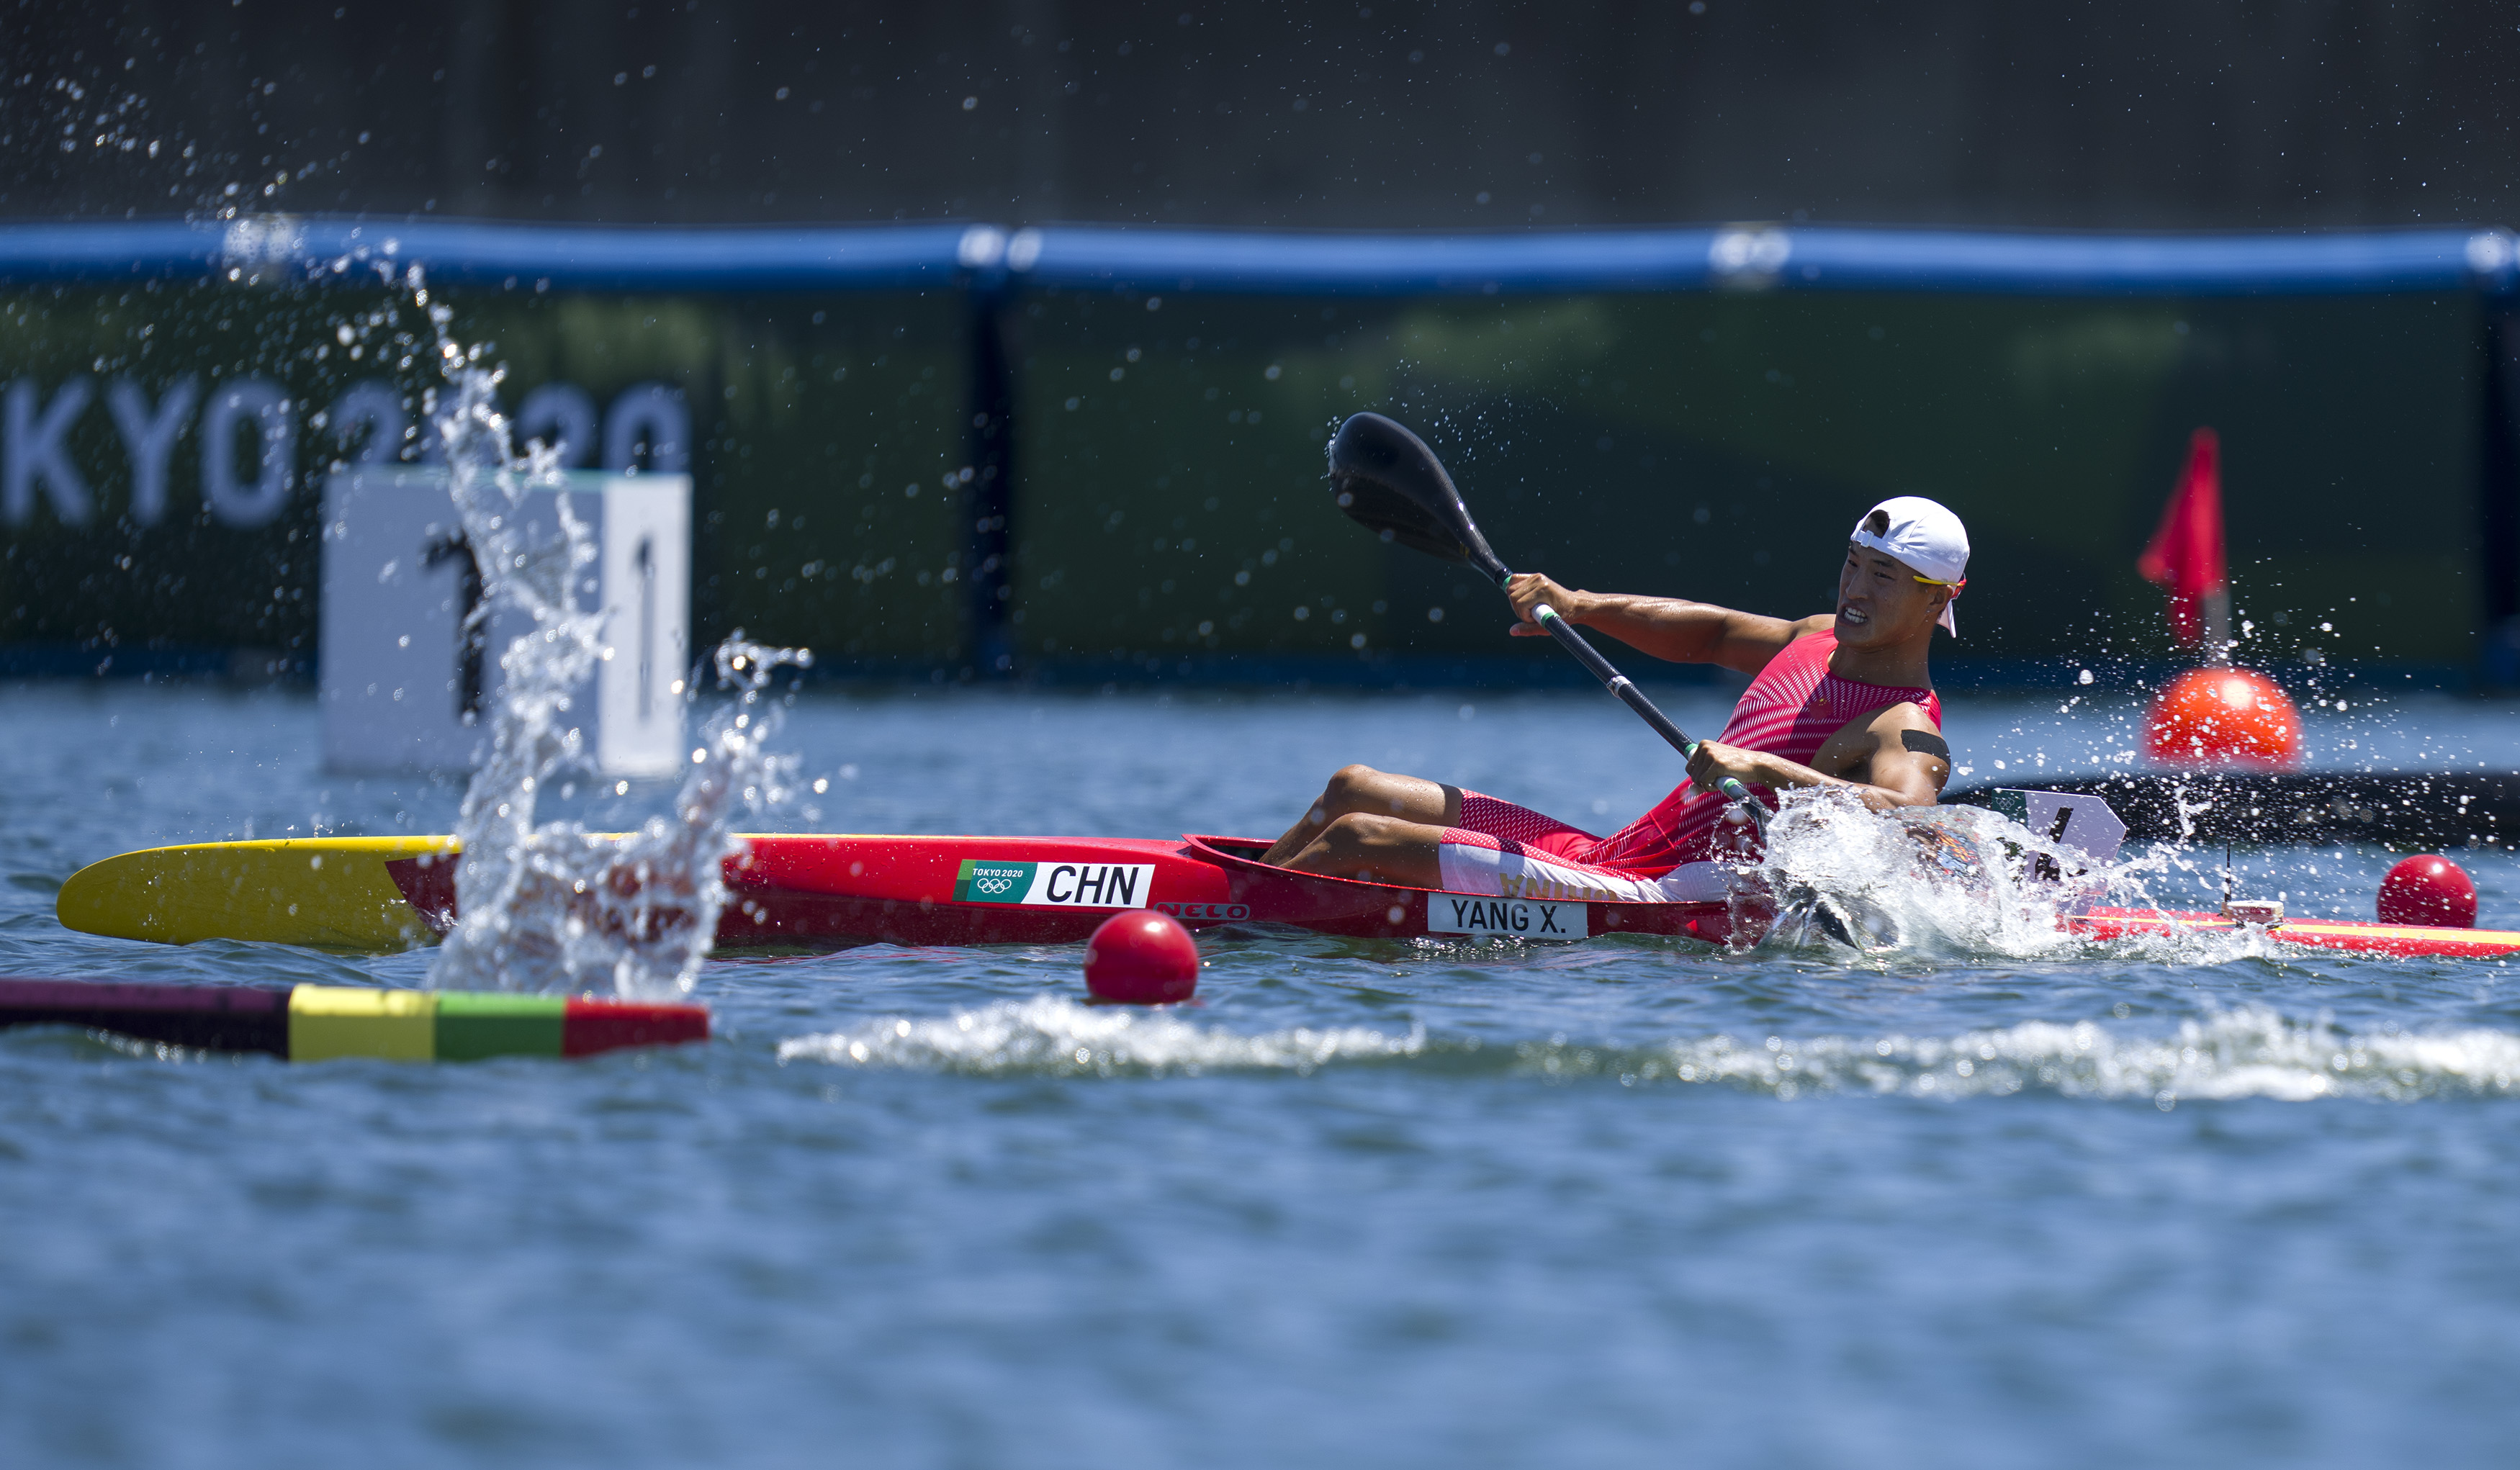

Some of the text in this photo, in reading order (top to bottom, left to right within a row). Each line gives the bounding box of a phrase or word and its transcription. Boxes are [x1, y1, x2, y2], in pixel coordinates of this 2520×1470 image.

[973, 867, 1024, 878] TOKYO 2020
[1046, 865, 1139, 905] CHN
[1156, 903, 1248, 919] NELO
[1450, 898, 1567, 934] YANG X.
